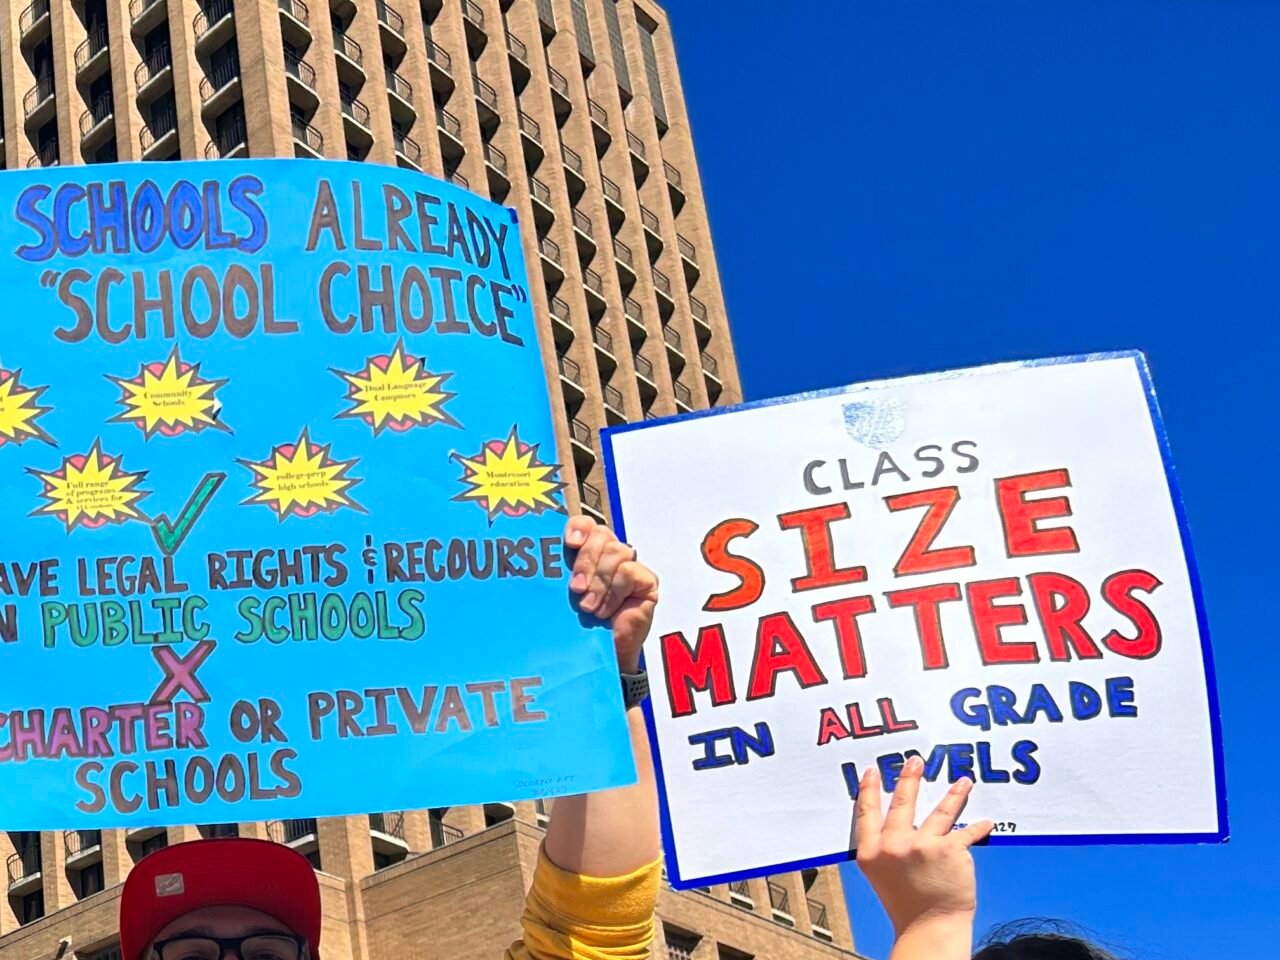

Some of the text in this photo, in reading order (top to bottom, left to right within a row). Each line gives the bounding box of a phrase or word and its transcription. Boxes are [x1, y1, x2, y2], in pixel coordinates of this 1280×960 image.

[15, 175, 269, 262] SCHOOLS
[304, 178, 509, 281] ALREADY
[365, 382, 427, 393] Dual Language
[143, 390, 193, 400] Community
[373, 393, 417, 402] Campuses
[152, 399, 186, 407] Schools
[802, 440, 980, 496] CLASS
[276, 471, 327, 480] college-prep
[486, 471, 532, 479] Montessori
[85, 481, 110, 490] range
[278, 480, 329, 491] high schools
[65, 488, 117, 498] of programs
[110, 494, 123, 502] for
[700, 468, 1081, 613] SIZE
[77, 554, 189, 597] LEGAL
[208, 544, 348, 591] RIGHTS
[384, 536, 567, 584] RECOURSE
[43, 596, 211, 649] PUBLIC
[234, 589, 427, 643] SCHOOLS
[660, 569, 1163, 718] MATTERS
[230, 698, 288, 743] OR
[308, 676, 547, 741] PRIVATE
[688, 676, 1139, 771] IN ALL GRADE
[75, 749, 302, 815] SCHOOLS
